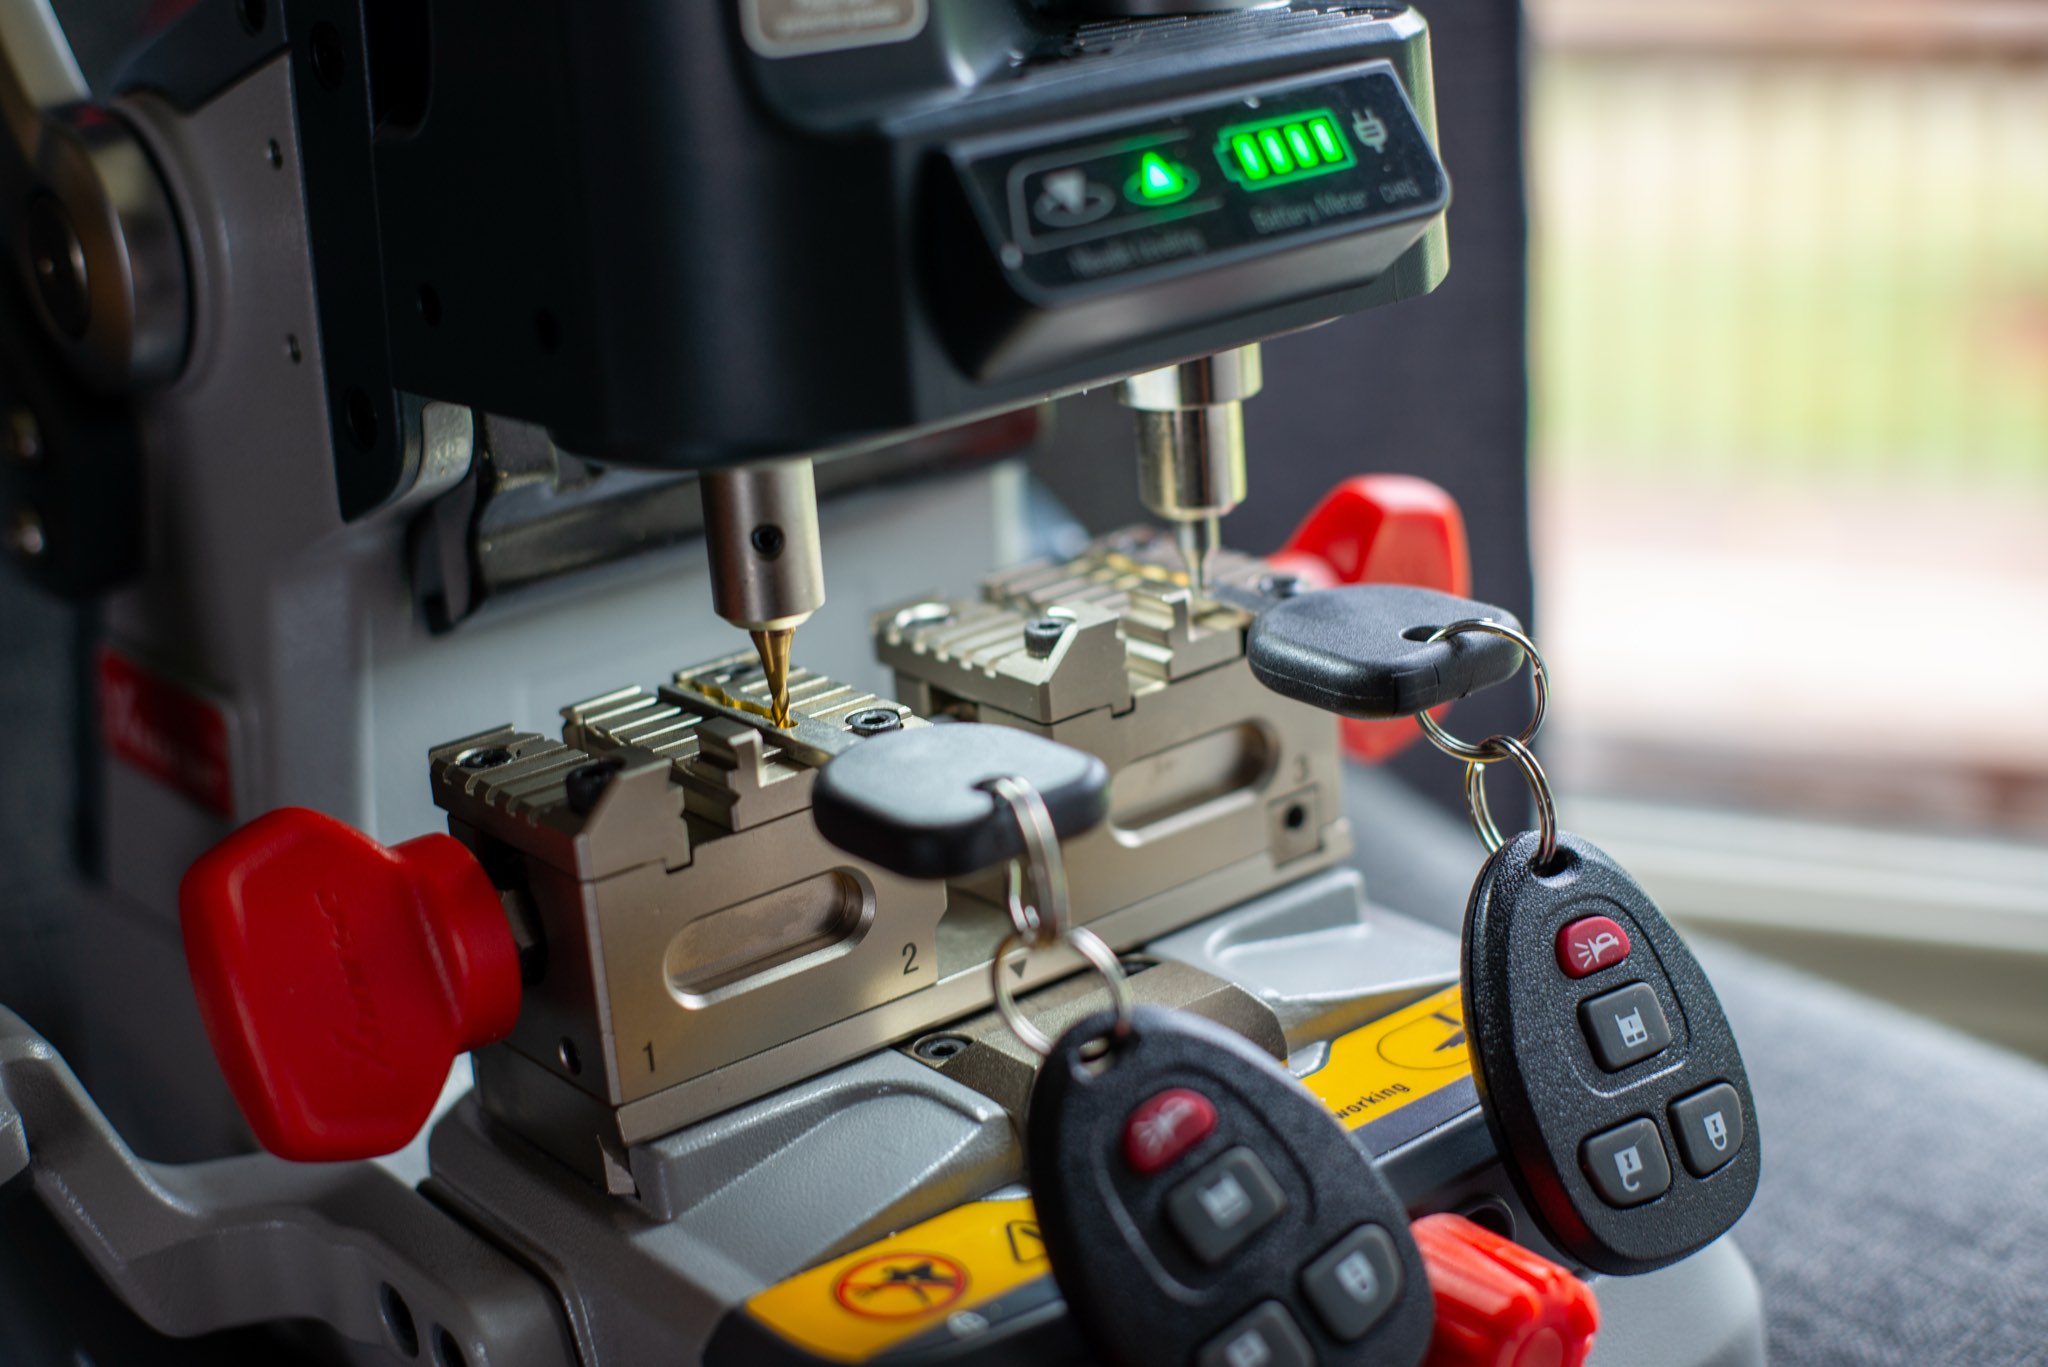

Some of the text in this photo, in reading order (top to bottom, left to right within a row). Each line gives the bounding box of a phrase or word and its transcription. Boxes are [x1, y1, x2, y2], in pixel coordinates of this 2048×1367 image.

[902, 941, 919, 976] 2
[642, 1041, 655, 1073] 1
[1335, 1083, 1410, 1120] working
